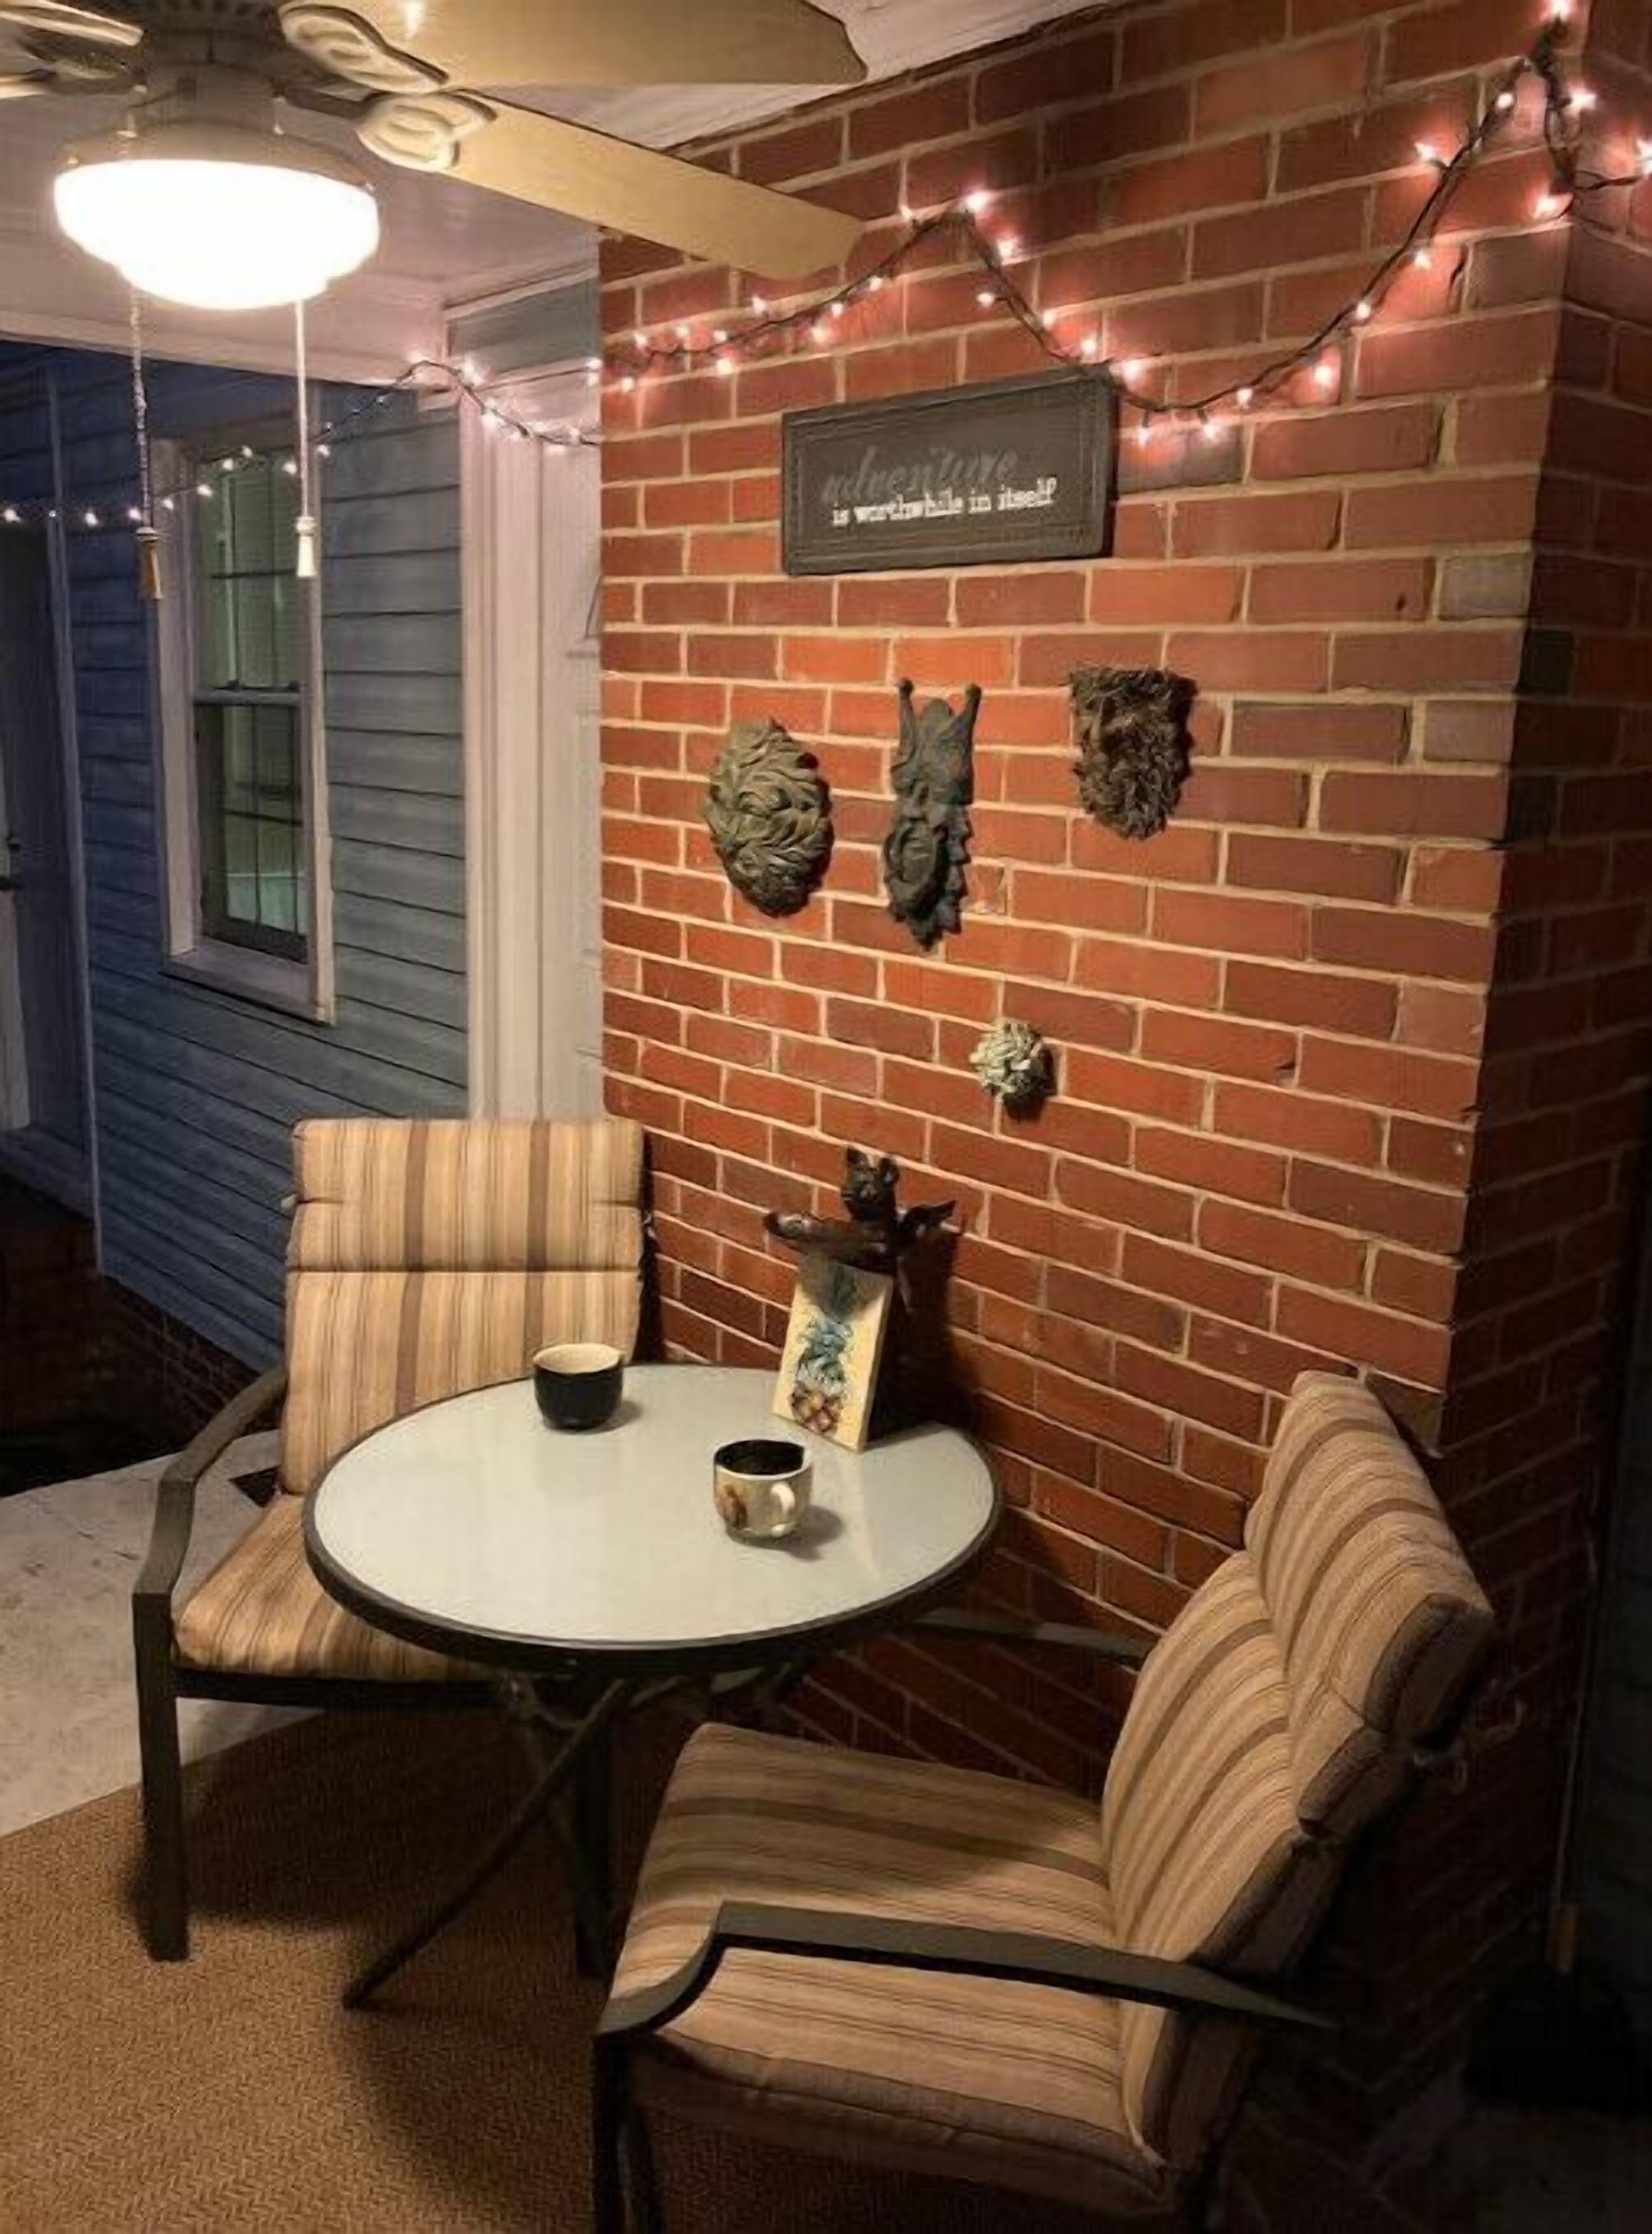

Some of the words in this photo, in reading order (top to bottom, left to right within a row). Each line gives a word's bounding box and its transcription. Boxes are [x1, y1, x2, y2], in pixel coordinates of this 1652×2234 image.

[832, 502, 850, 527] is
[854, 488, 963, 523] worthwhile
[968, 488, 992, 514] in
[997, 476, 1057, 510] itself
